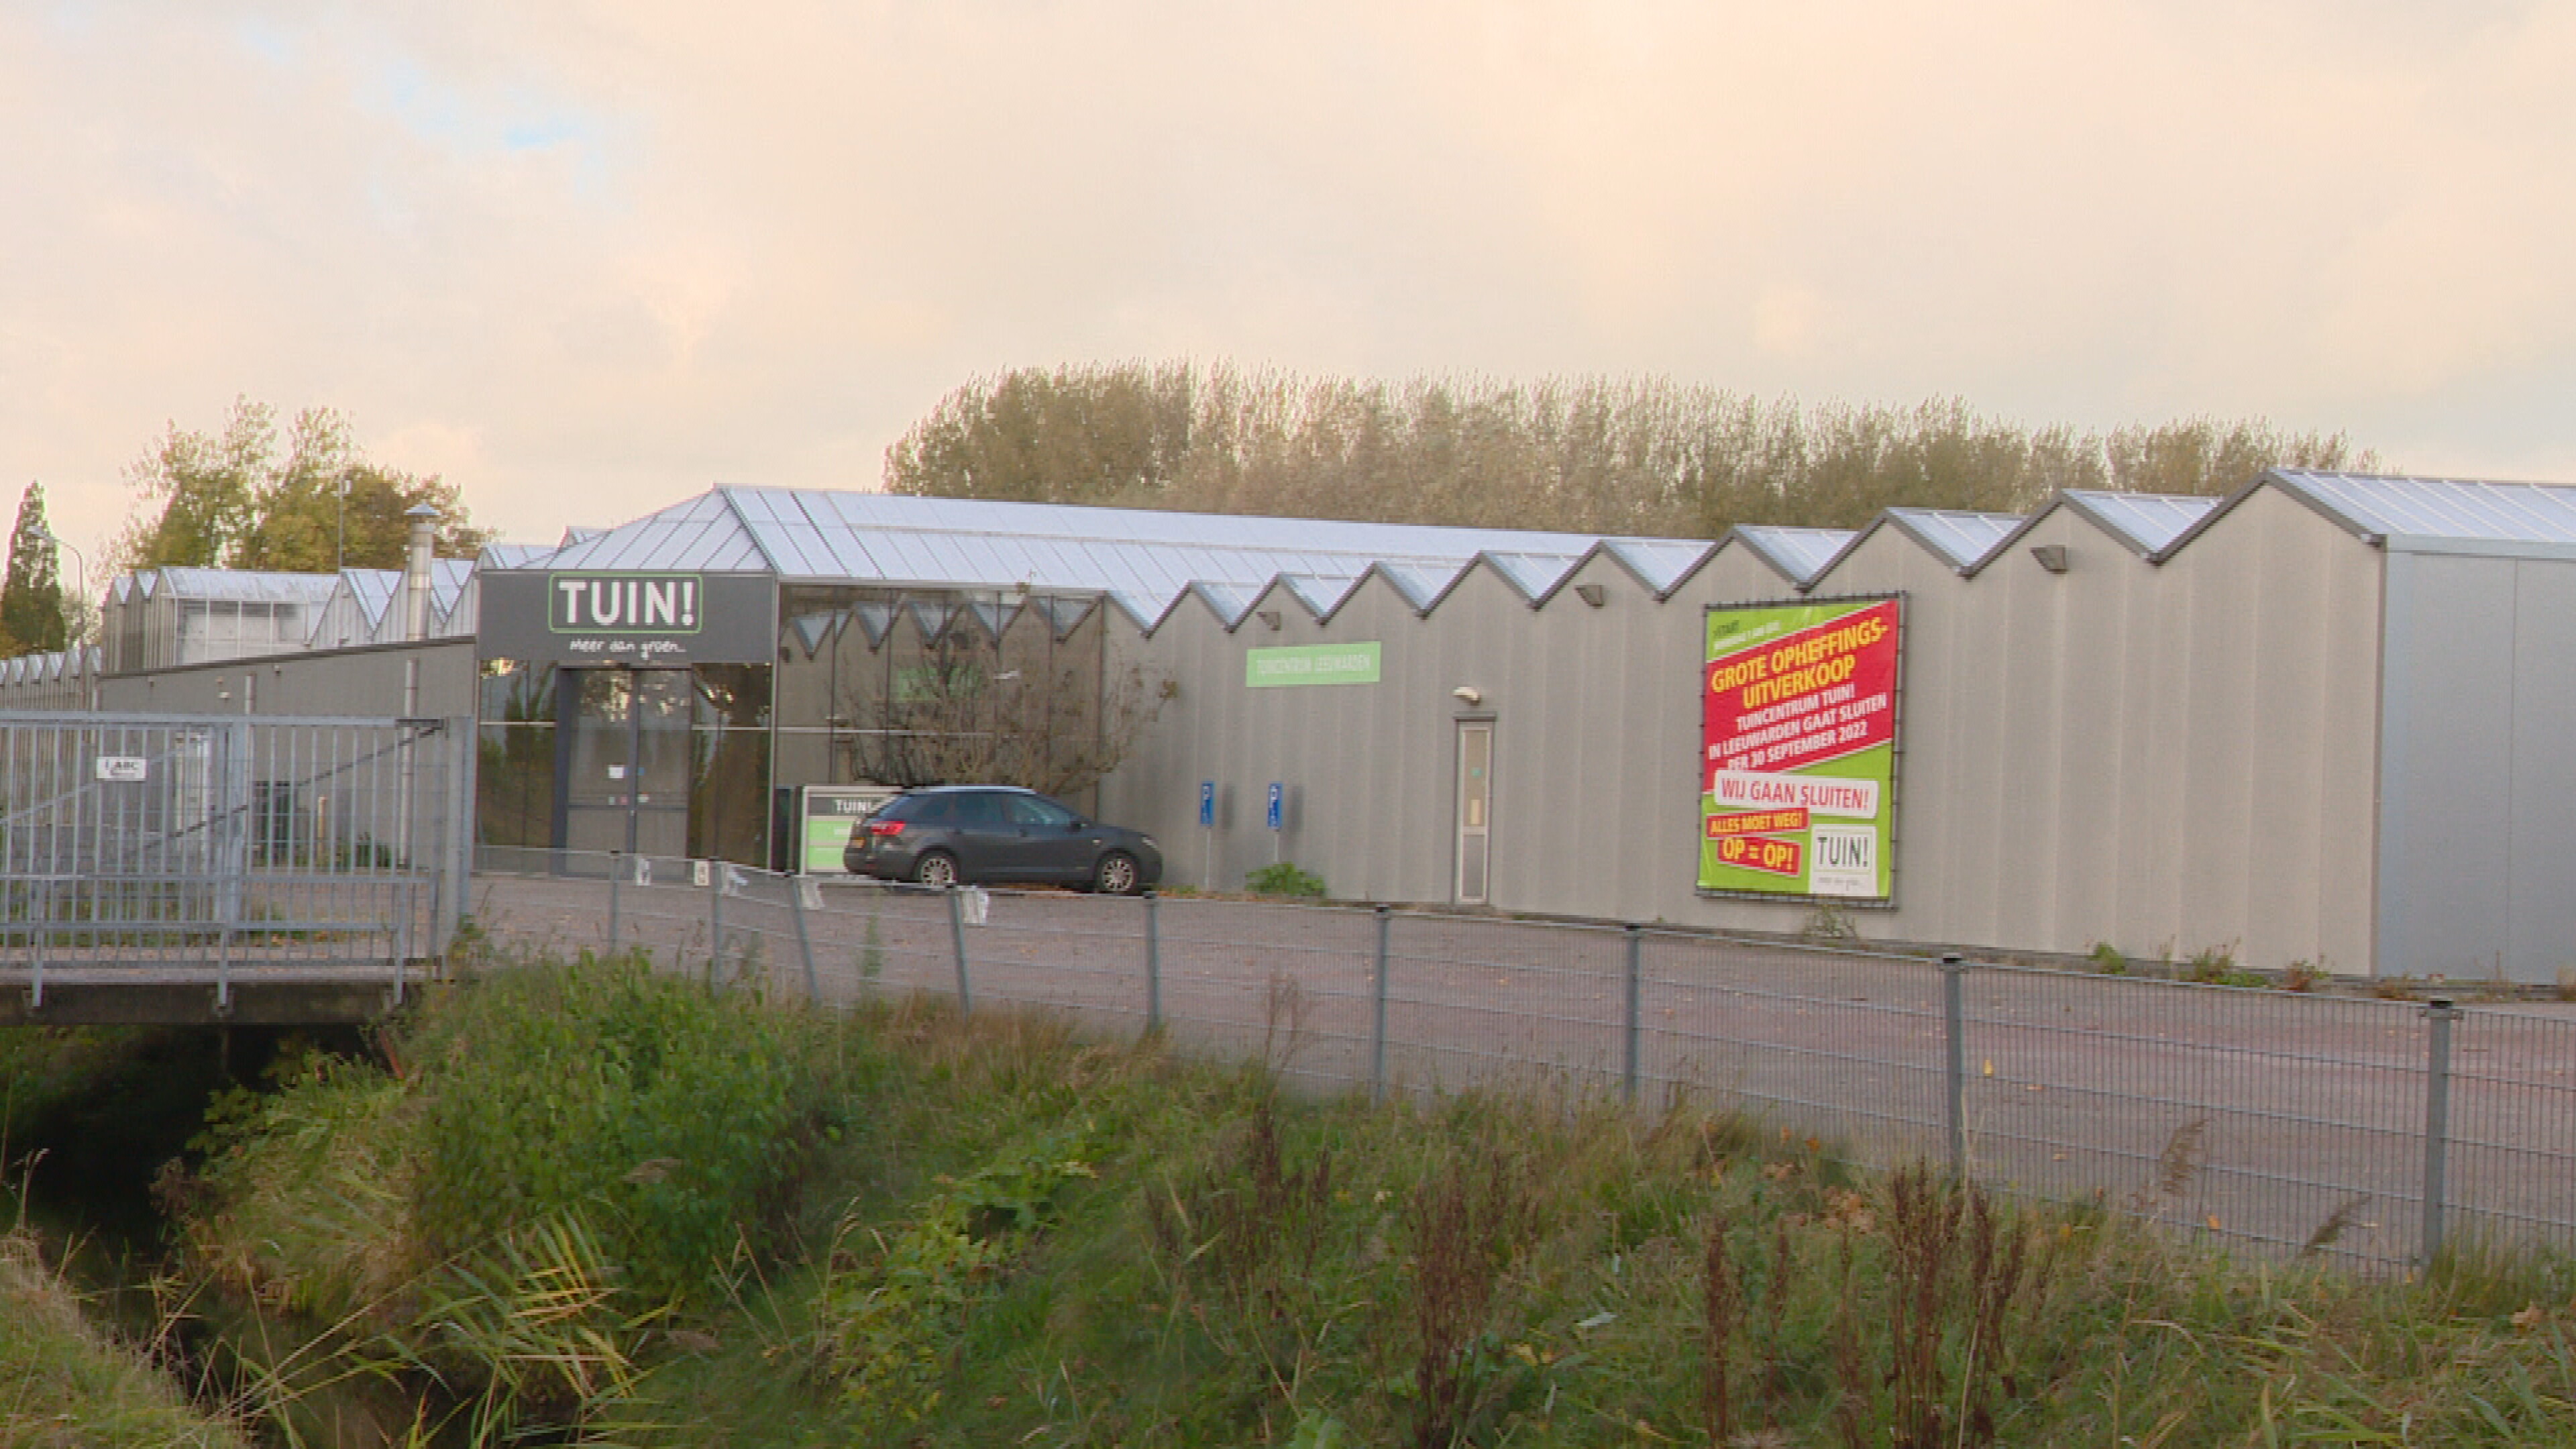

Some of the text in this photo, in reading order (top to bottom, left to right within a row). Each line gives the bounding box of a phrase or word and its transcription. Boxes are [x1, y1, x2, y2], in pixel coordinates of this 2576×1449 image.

[559, 581, 695, 626] TUIN!
[1712, 655, 1768, 693] GROTE
[1771, 617, 1888, 674] OPHEFFINGS-
[1743, 654, 1856, 709] UITVERKOOP
[1709, 692, 1888, 760] IN LEEUWARDEN GAAT SLUITEN
[1735, 682, 1855, 731] TUINCENTRUM TUIN!
[1751, 749, 1766, 767] 30
[1766, 729, 1837, 763] SEPTEMBER
[1838, 718, 1868, 743] 2022
[1721, 777, 1869, 809] WIJ GAAN SLUITEN!
[1711, 812, 1803, 834] ALLES MOET WEG!
[1723, 837, 1746, 859] OP
[1763, 844, 1794, 870] OP!
[1817, 837, 1869, 867] TUIN!
